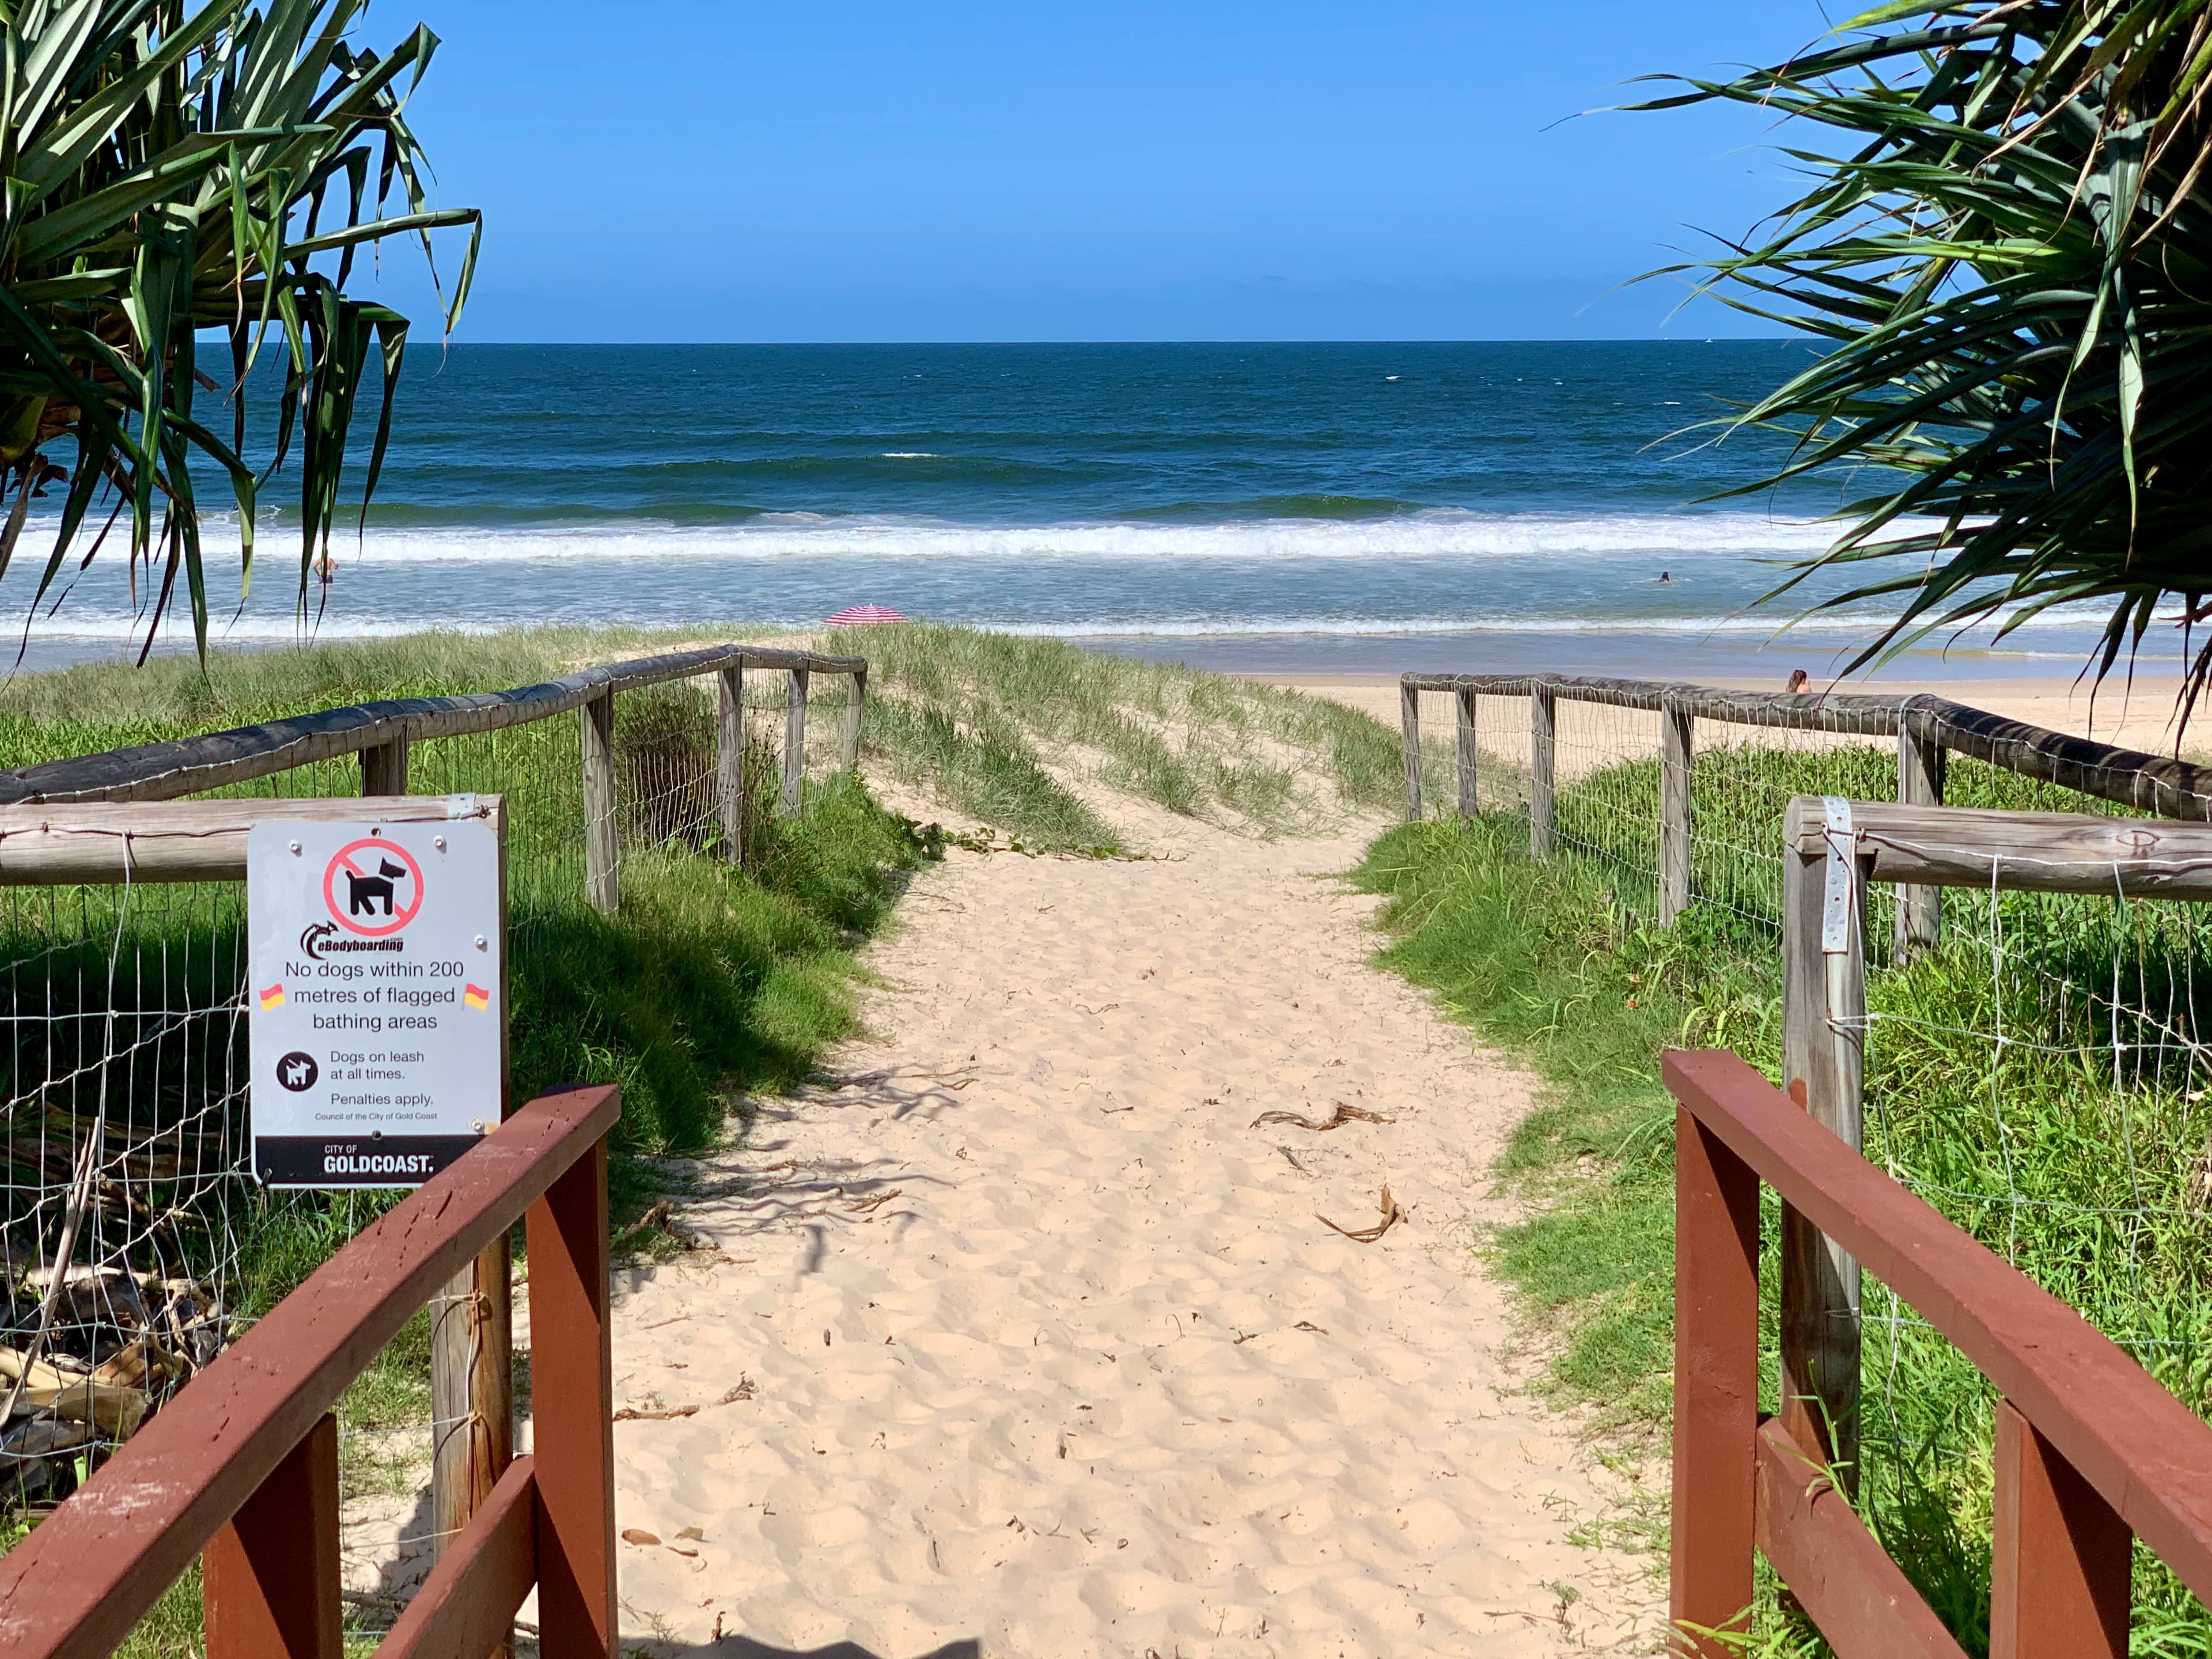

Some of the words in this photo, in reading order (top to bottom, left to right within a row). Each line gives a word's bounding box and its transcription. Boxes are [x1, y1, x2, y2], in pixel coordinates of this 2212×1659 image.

[318, 940, 403, 952] eBodyboarding
[286, 962, 311, 977] No
[318, 961, 363, 980] dogs
[370, 961, 423, 977] within
[430, 961, 464, 977] 200
[295, 988, 357, 1003] metres
[363, 987, 381, 1003] of
[387, 987, 454, 1006] flagged
[313, 1013, 381, 1032] bathing
[388, 1016, 437, 1028] areas
[331, 1051, 365, 1065] Dogs
[369, 1054, 385, 1062] on
[391, 1051, 424, 1062] leash
[331, 1069, 342, 1079] at
[347, 1069, 361, 1079] all
[366, 1068, 405, 1080] times.
[331, 1094, 391, 1105] Penalties
[395, 1093, 433, 1107] apply.
[369, 1113, 384, 1121] City
[324, 1145, 343, 1153] CITY
[346, 1145, 357, 1153] OF
